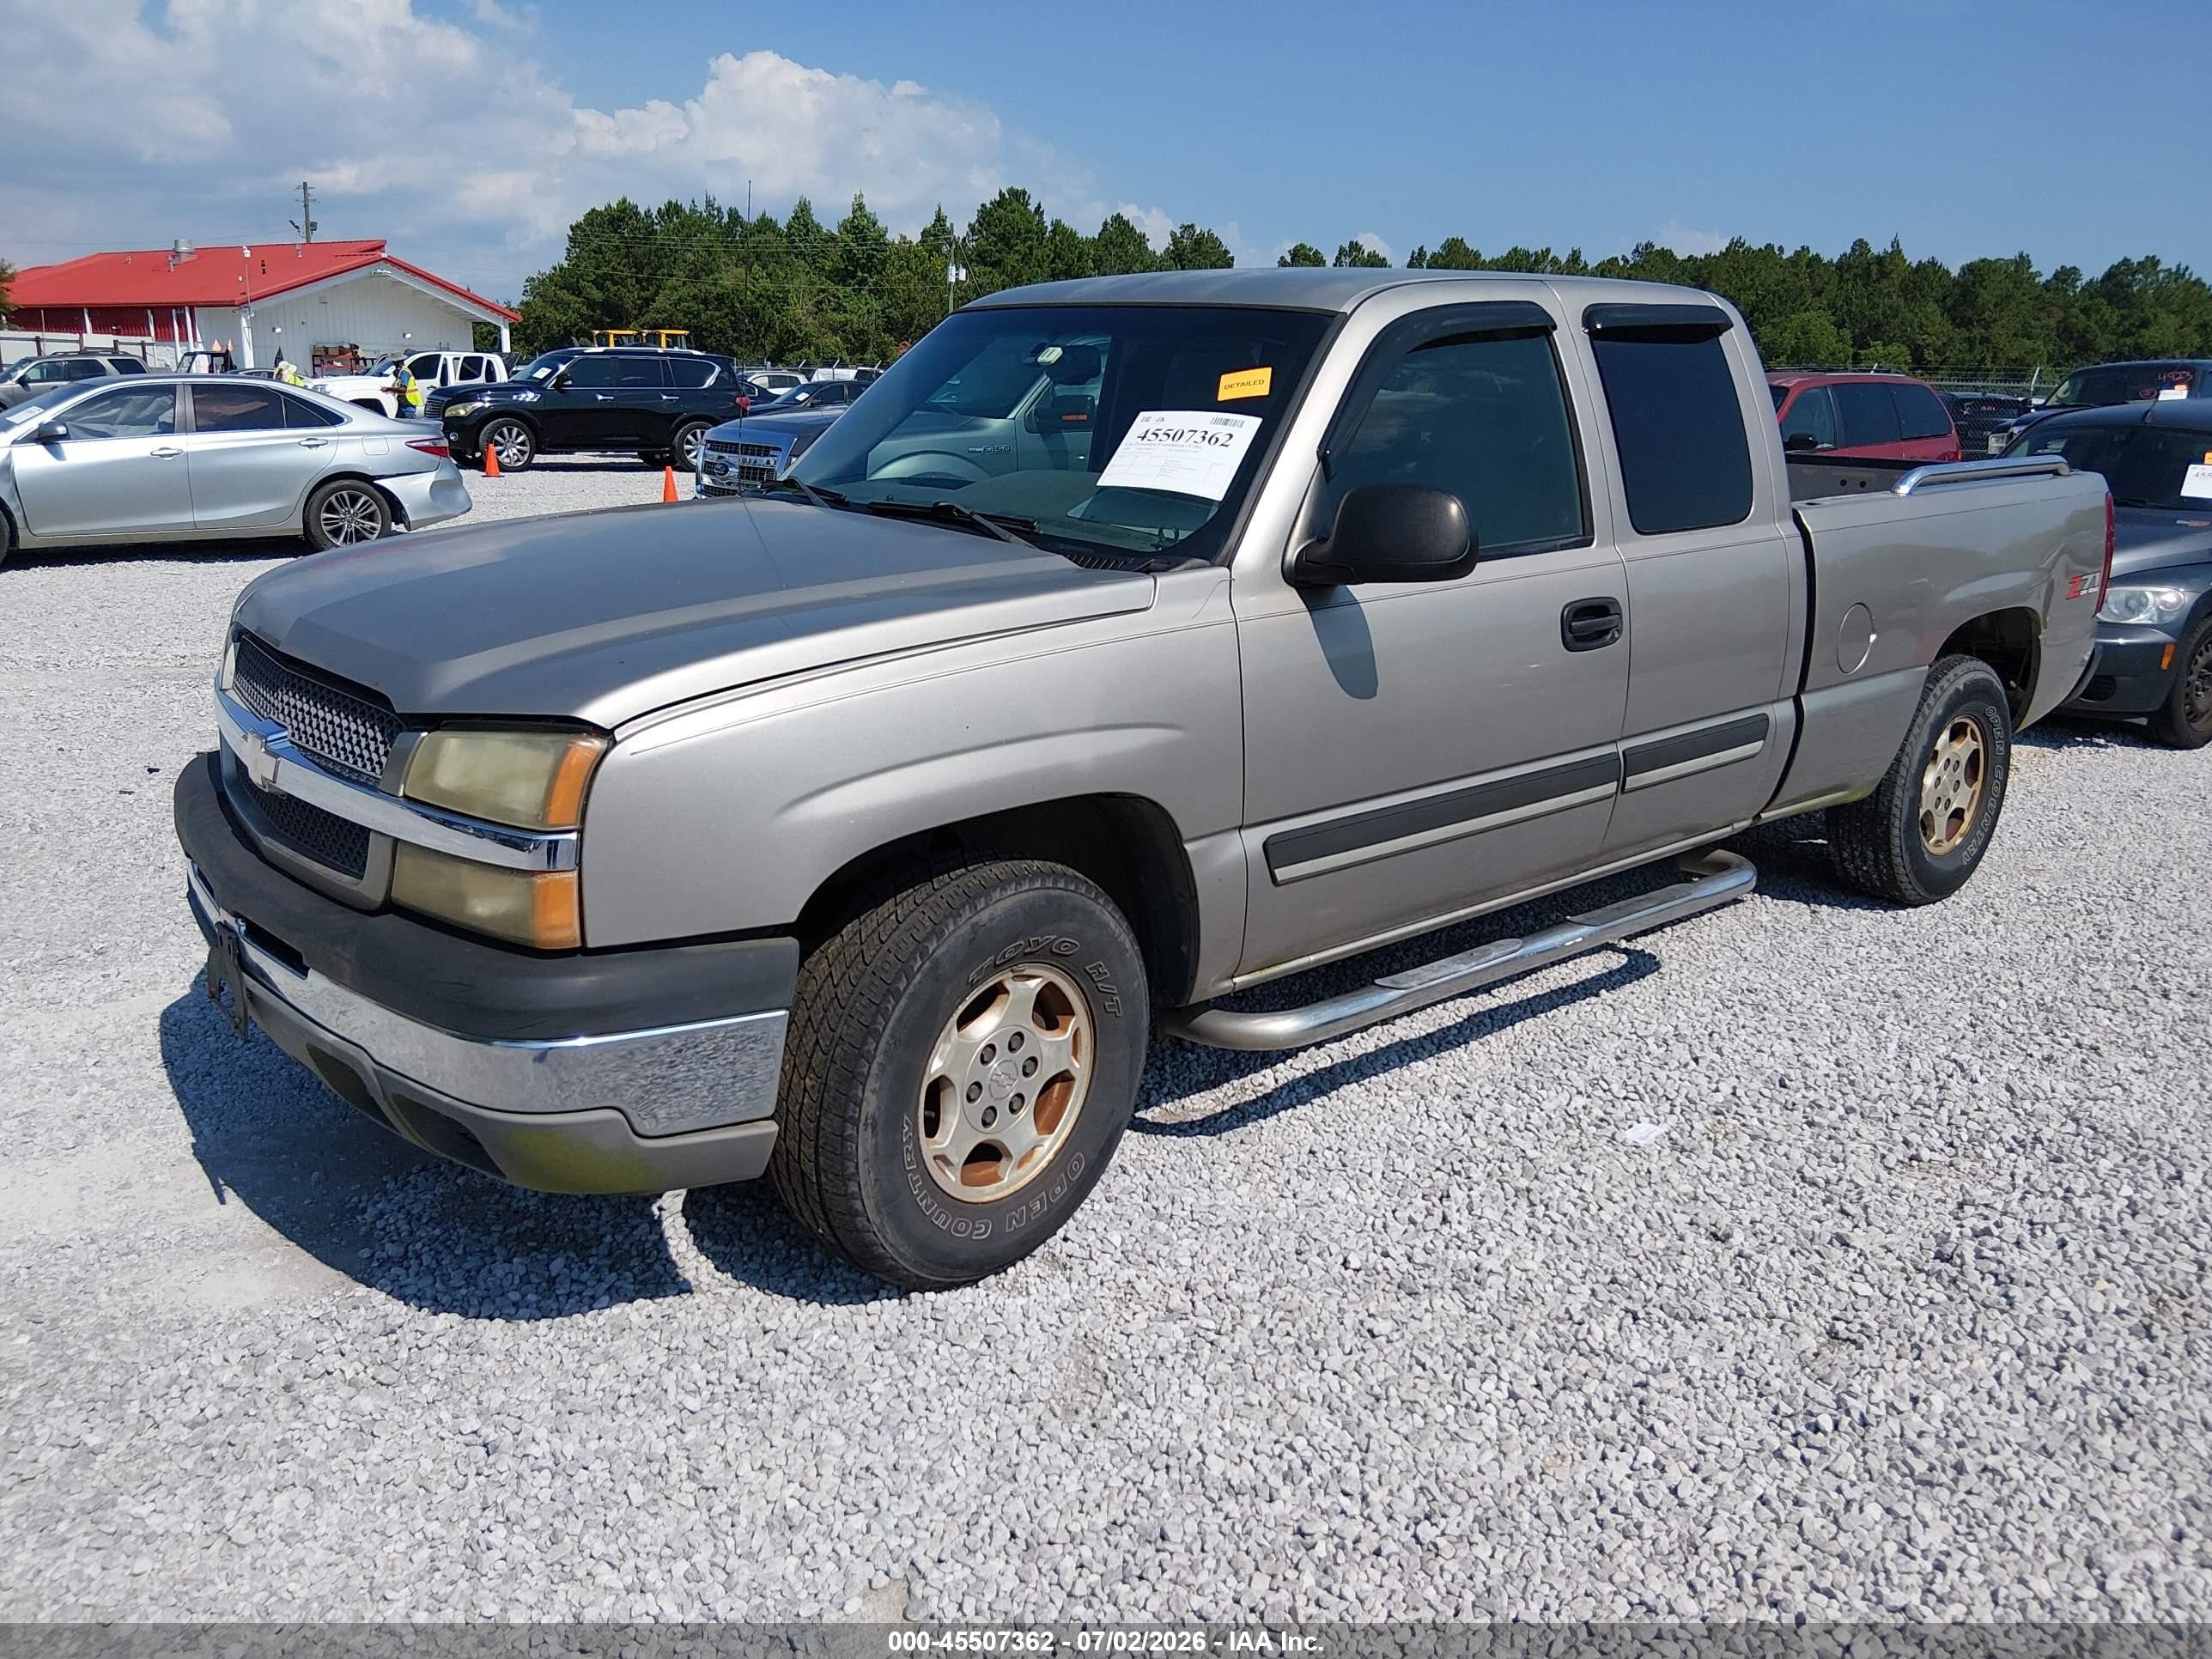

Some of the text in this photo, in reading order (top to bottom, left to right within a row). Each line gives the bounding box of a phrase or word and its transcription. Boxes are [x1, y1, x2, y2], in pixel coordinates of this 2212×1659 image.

[1224, 379, 1264, 390] DETAILED
[1136, 428, 1234, 447] 45507362
[1985, 705, 2005, 757] OPEN
[968, 935, 1079, 984] TOYO
[1085, 961, 1122, 1018] H/T
[902, 1115, 1085, 1240] OPEN COUNTRY
